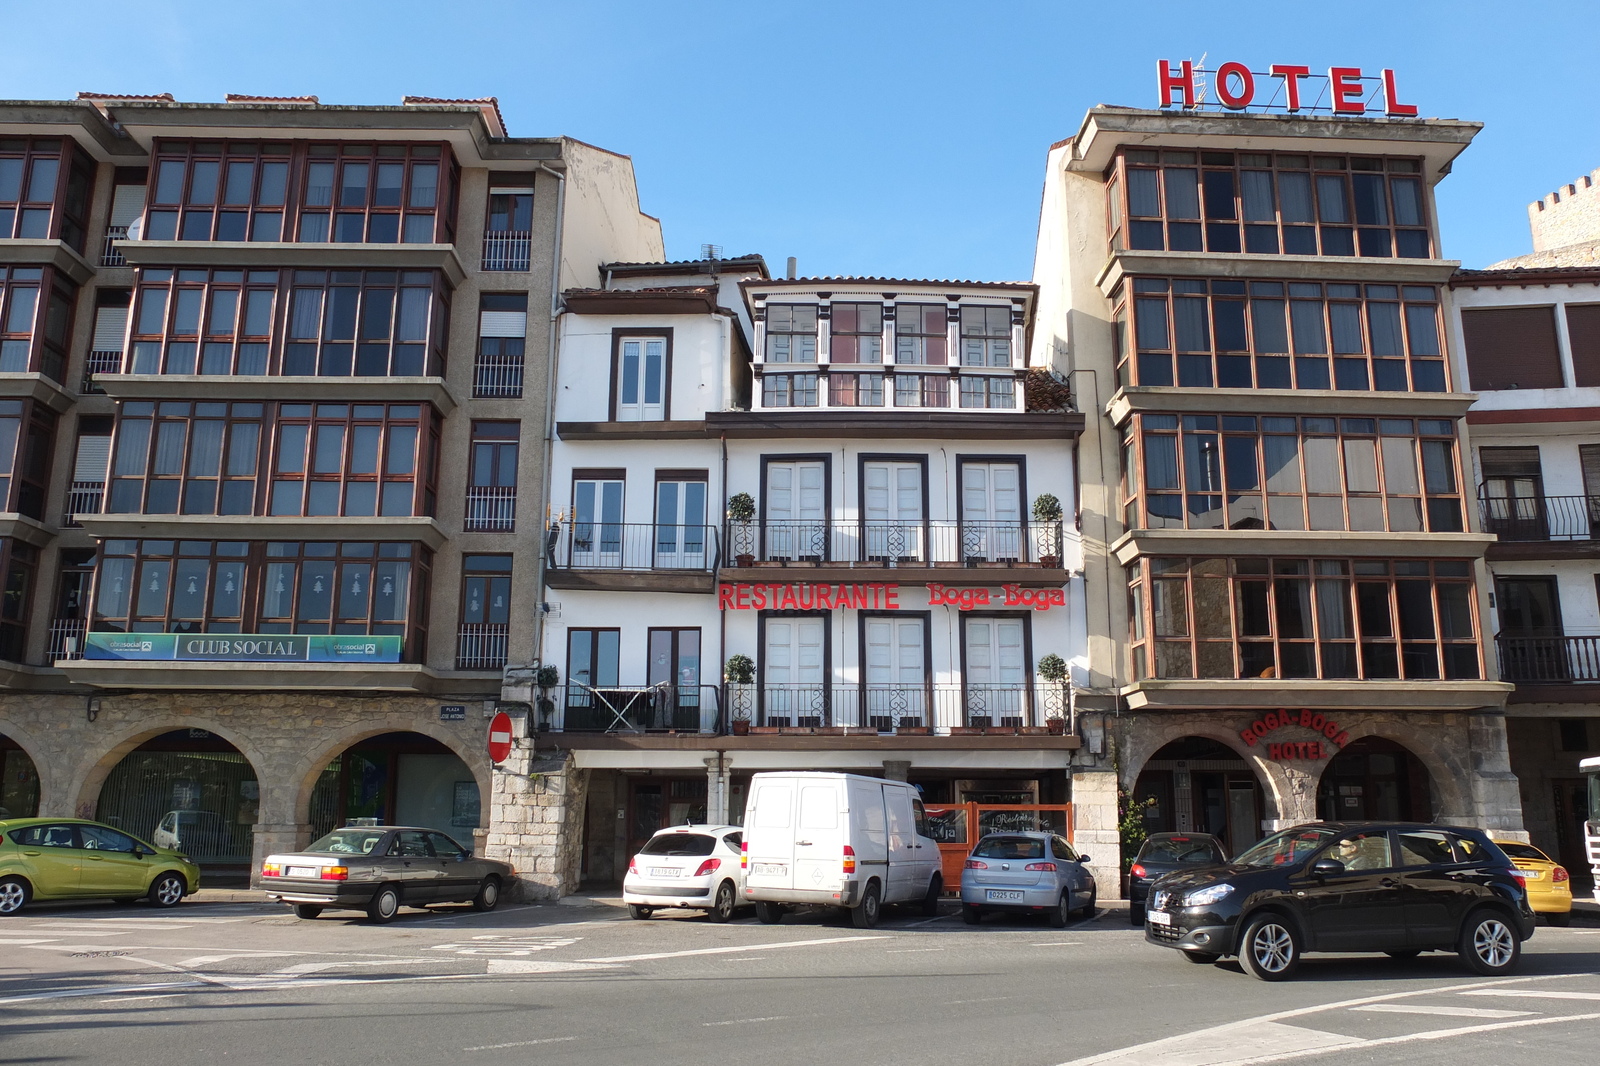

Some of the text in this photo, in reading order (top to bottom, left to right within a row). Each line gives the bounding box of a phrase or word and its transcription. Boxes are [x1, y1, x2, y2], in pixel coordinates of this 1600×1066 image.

[1156, 59, 1418, 117] HOTEL
[718, 582, 900, 610] RESTAURANTE
[187, 640, 297, 655] CLUB SOCIAL
[1240, 708, 1350, 748] BOGA-BOGA
[1268, 741, 1328, 761] HOTEL
